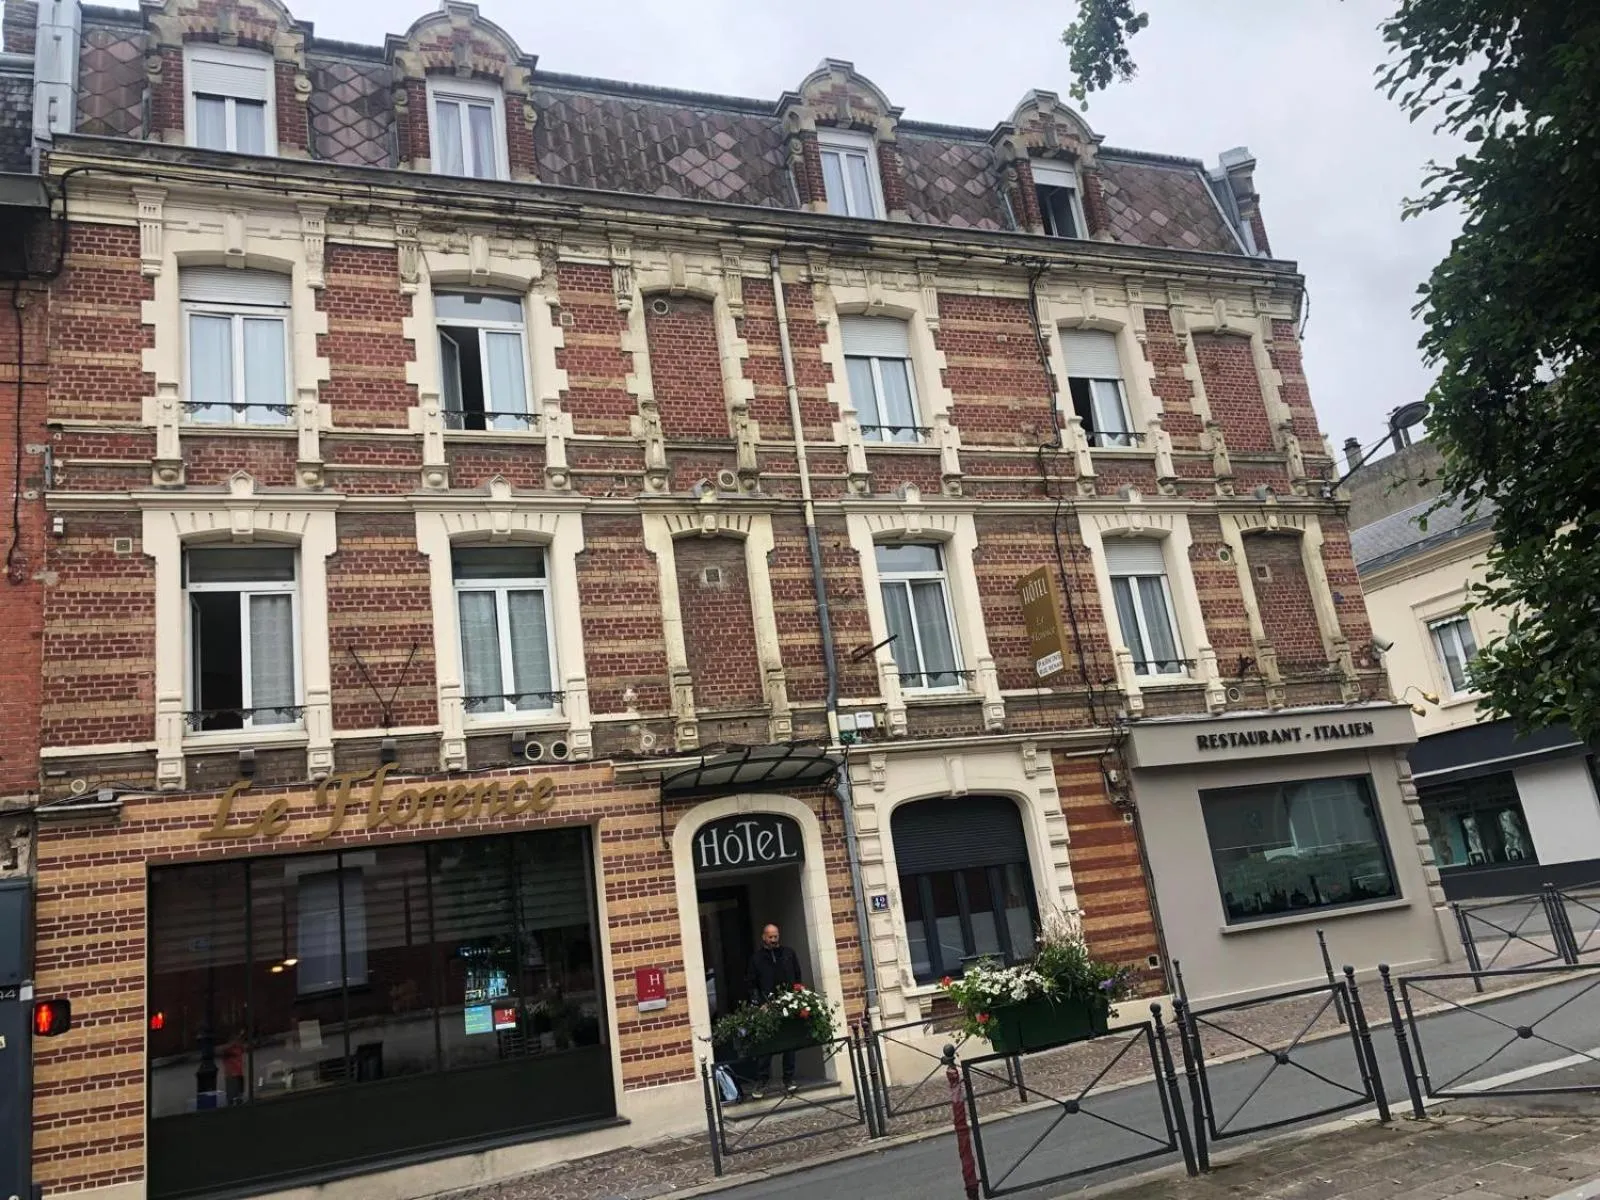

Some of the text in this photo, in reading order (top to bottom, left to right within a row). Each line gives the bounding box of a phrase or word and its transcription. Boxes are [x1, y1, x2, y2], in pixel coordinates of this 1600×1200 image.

[1196, 727, 1301, 750] RESTAURANT
[1313, 722, 1374, 741] ITALIEN
[200, 762, 556, 841] Le Florence
